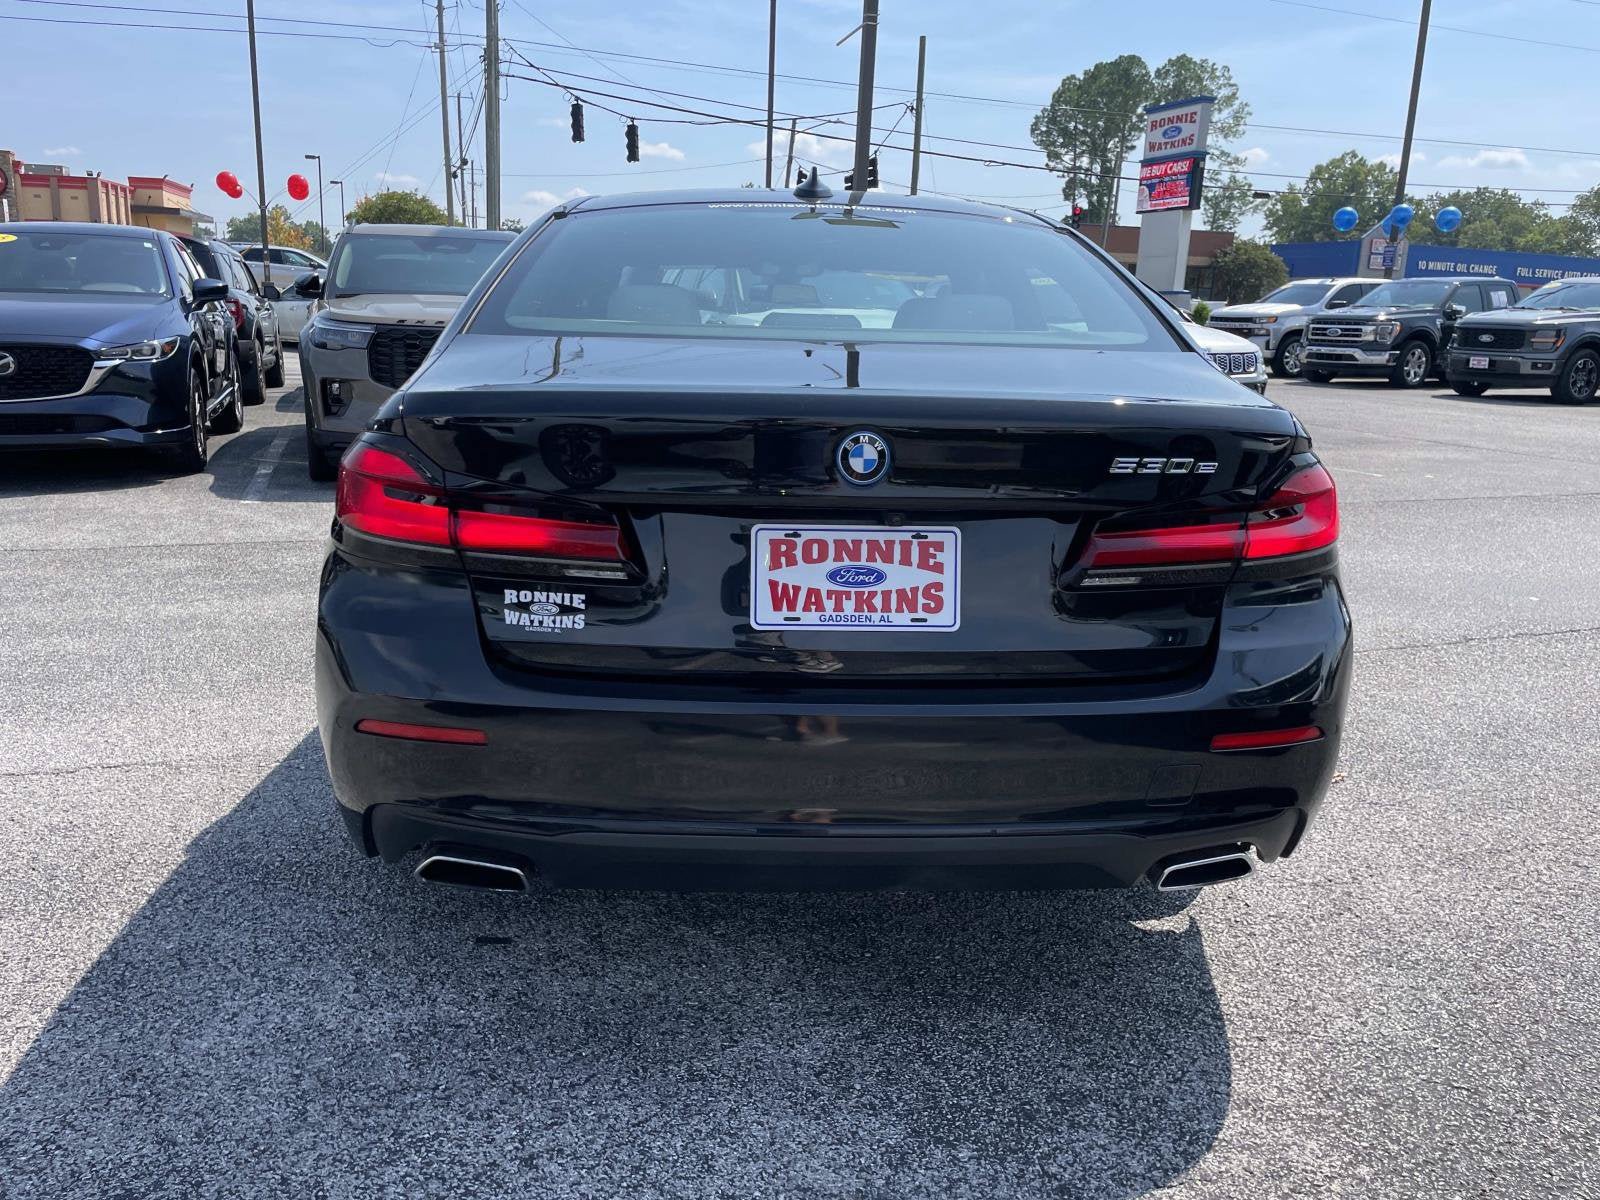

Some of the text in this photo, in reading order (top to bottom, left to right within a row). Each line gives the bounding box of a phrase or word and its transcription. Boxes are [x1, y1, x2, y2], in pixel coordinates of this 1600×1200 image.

[1150, 112, 1197, 132] RONNIE
[1149, 134, 1195, 152] WATKINS
[1152, 164, 1167, 176] BUY
[1167, 160, 1190, 174] CARS!
[1418, 261, 1497, 274] 10 MINUTE OIL CHANGE
[1516, 267, 1533, 277] FULL
[1535, 268, 1561, 279] SERVICE
[845, 435, 883, 451] BMW
[1109, 457, 1218, 474] 530e
[768, 538, 945, 574] RONNIE
[836, 569, 877, 583] Ford
[504, 589, 586, 610] RONNIE
[768, 578, 945, 614] WATKINS
[503, 608, 585, 629] WATKINS
[818, 614, 893, 624] GADSDEN, AL
